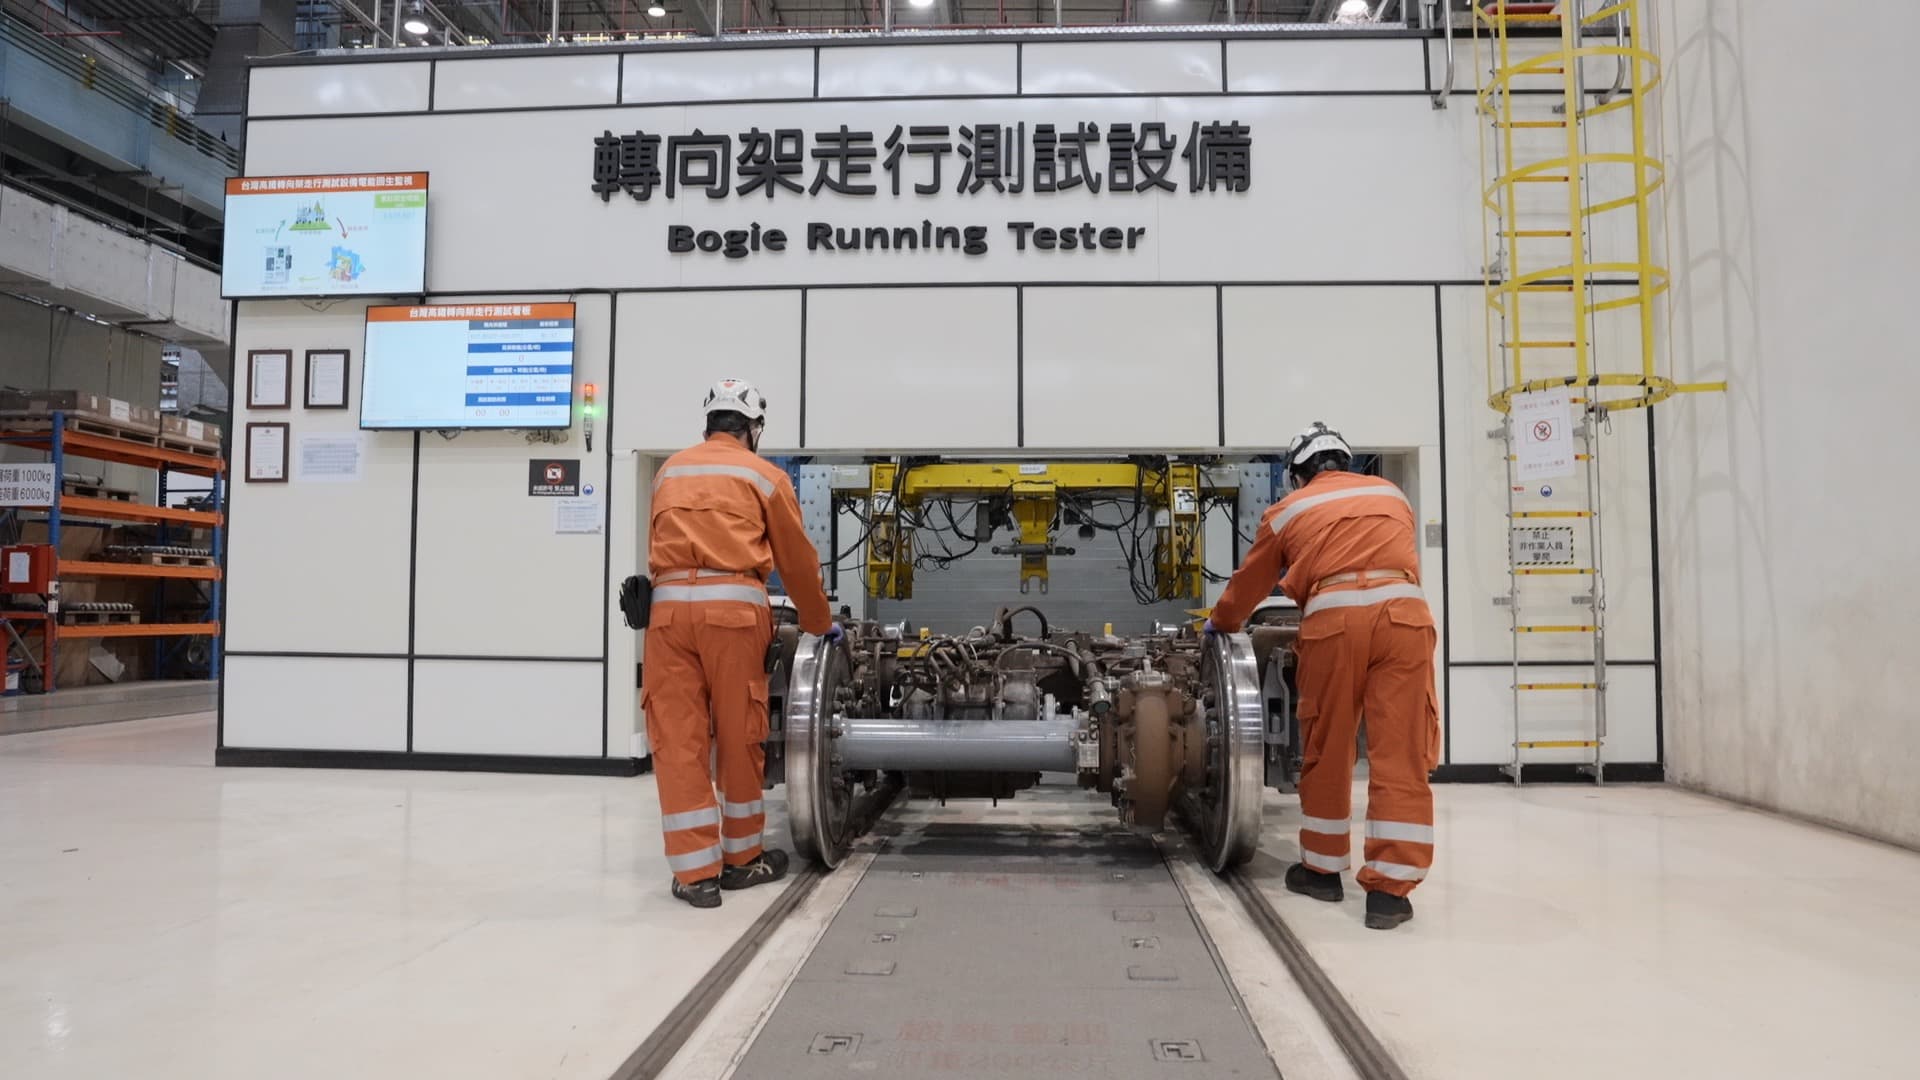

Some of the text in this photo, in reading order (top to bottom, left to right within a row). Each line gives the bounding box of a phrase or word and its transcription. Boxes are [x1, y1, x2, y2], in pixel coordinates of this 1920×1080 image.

[591, 120, 1253, 201] 轉向架走行測試設備
[667, 218, 1146, 258] Bogie Running Tester
[22, 470, 51, 484] 1000kg
[20, 488, 50, 502] 6000kg
[1532, 531, 1550, 540] 禁止
[1520, 541, 1564, 551] 非作業人員
